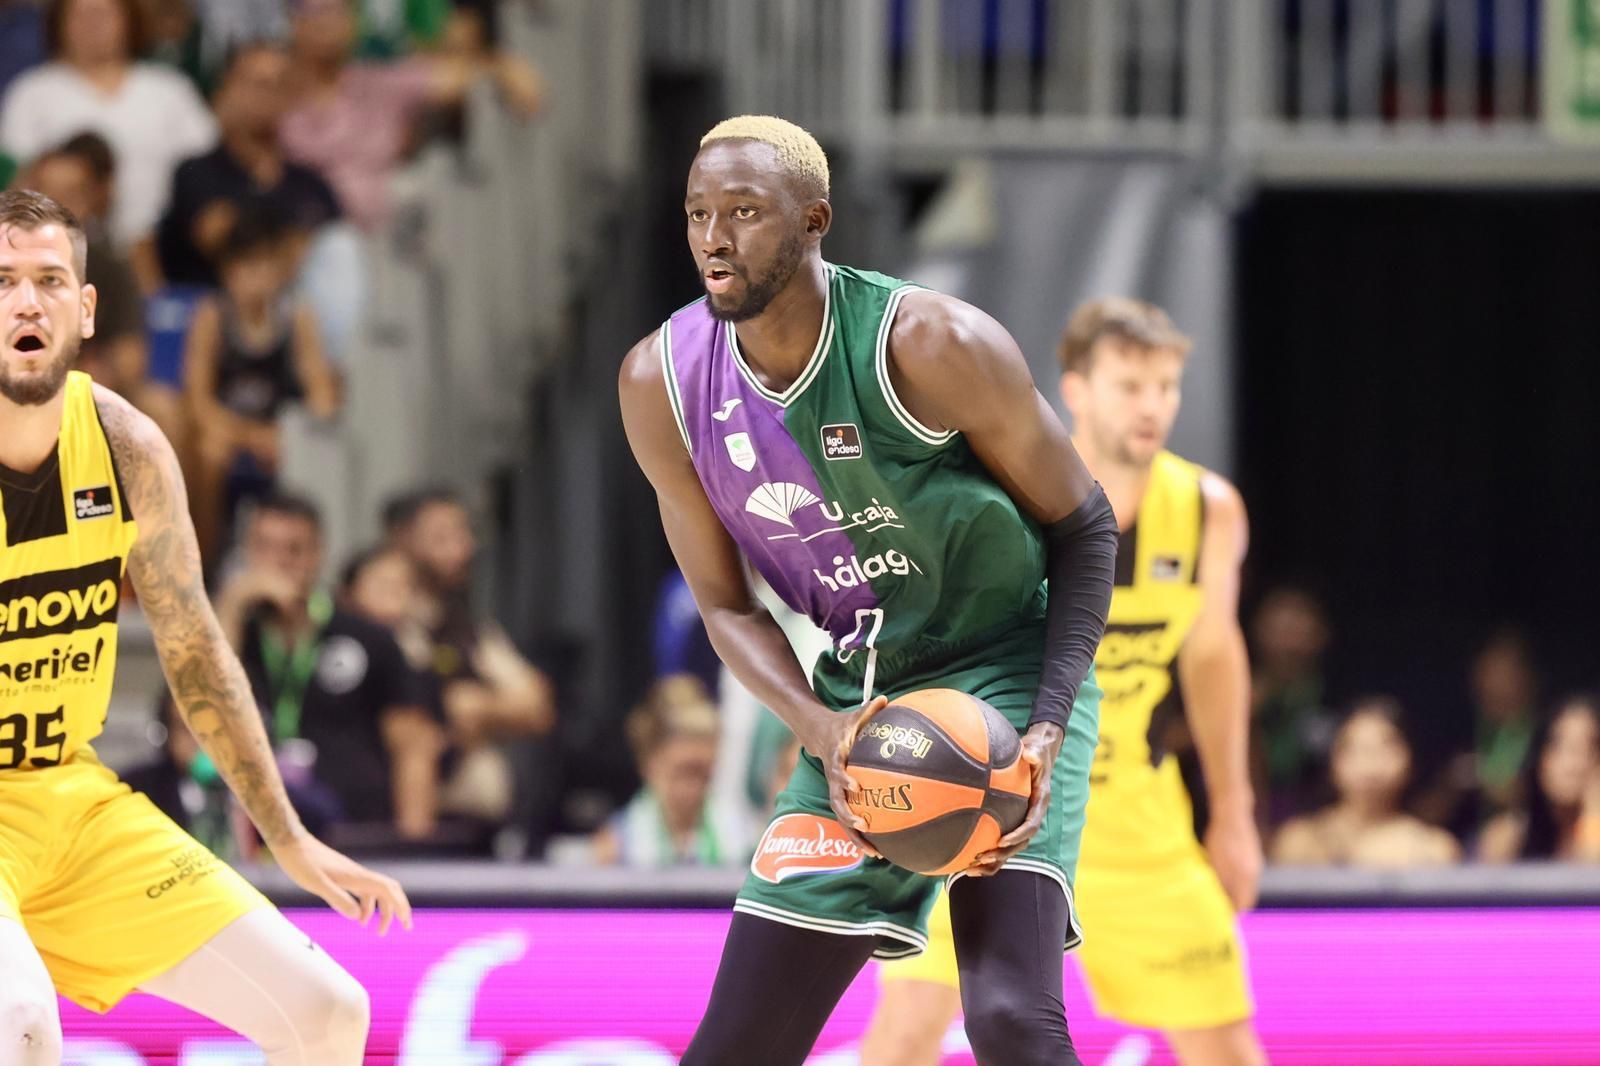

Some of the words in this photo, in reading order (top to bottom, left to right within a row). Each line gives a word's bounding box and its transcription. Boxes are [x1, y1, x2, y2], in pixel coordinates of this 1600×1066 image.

[825, 436, 843, 447] liga
[828, 445, 860, 455] endesa
[818, 497, 899, 525] Ucaja
